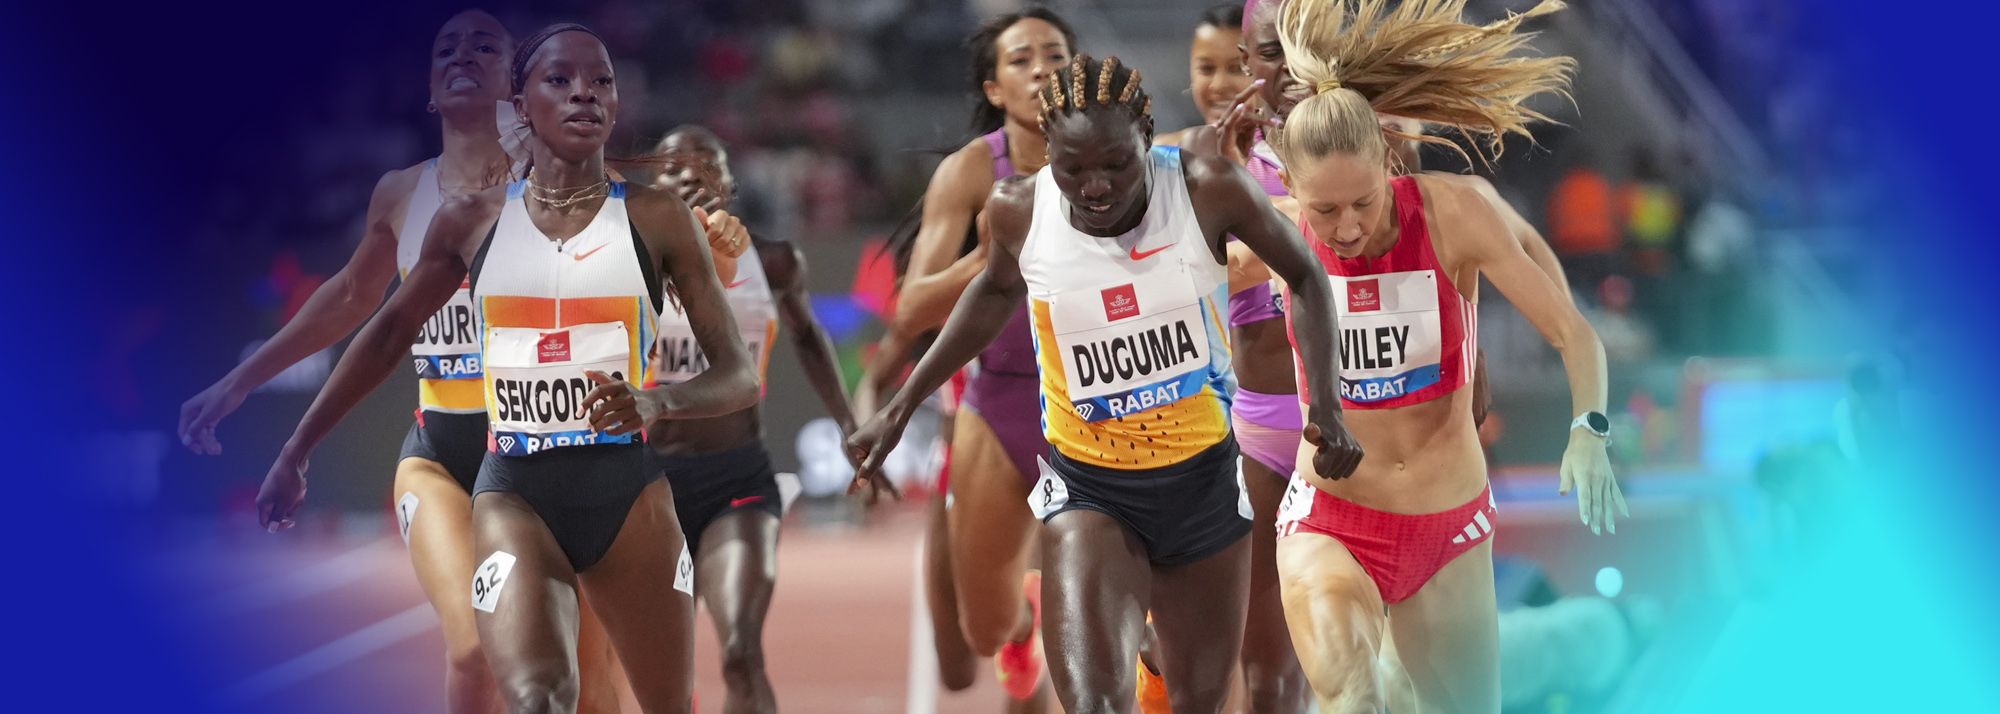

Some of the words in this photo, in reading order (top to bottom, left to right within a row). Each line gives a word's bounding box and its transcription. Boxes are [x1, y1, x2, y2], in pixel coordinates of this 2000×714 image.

[439, 357, 482, 376] RAB
[1072, 320, 1199, 388] DUGUMA
[1108, 381, 1181, 417] RABAT
[1340, 377, 1407, 400] RABAT
[1043, 478, 1053, 508] 8
[475, 562, 502, 604] 9.2
